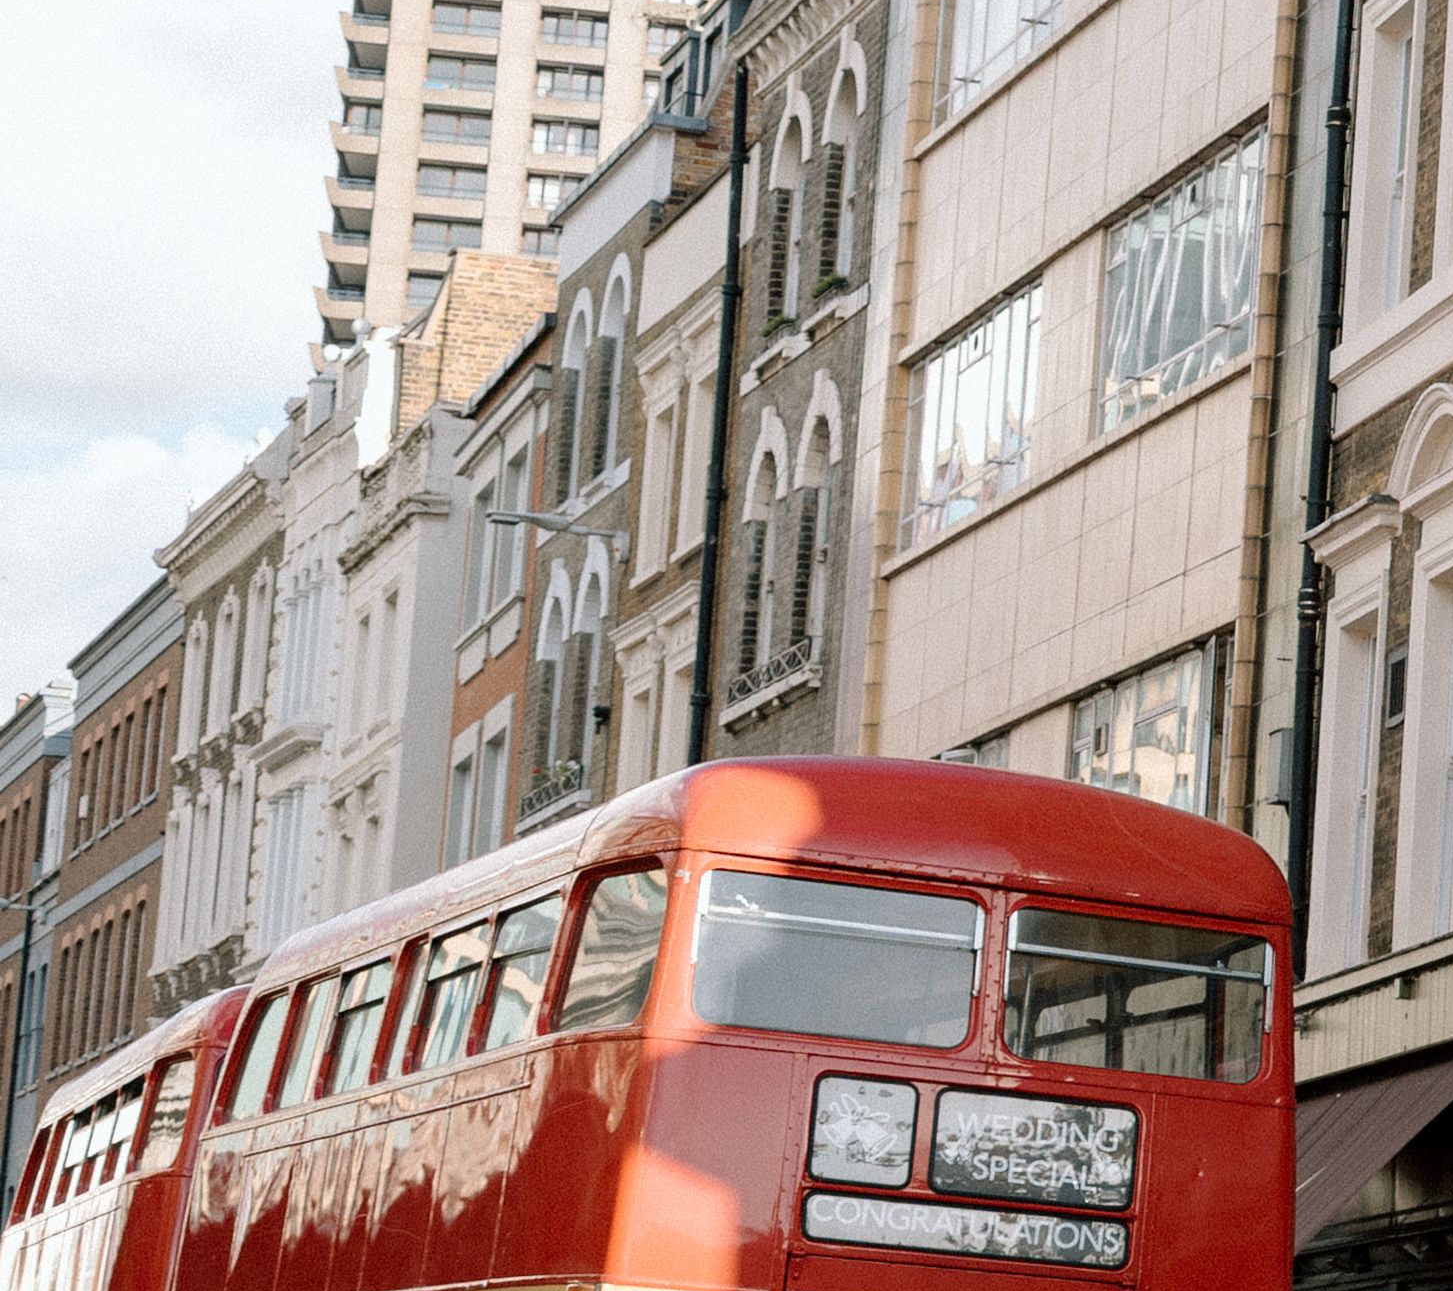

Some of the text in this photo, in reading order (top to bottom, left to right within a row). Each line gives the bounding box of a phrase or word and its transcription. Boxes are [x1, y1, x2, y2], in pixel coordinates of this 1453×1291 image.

[958, 1112, 1119, 1153] WEDDING
[972, 1152, 1098, 1192] SPECIAL
[810, 1196, 1120, 1254] CONGRATULATIONS
